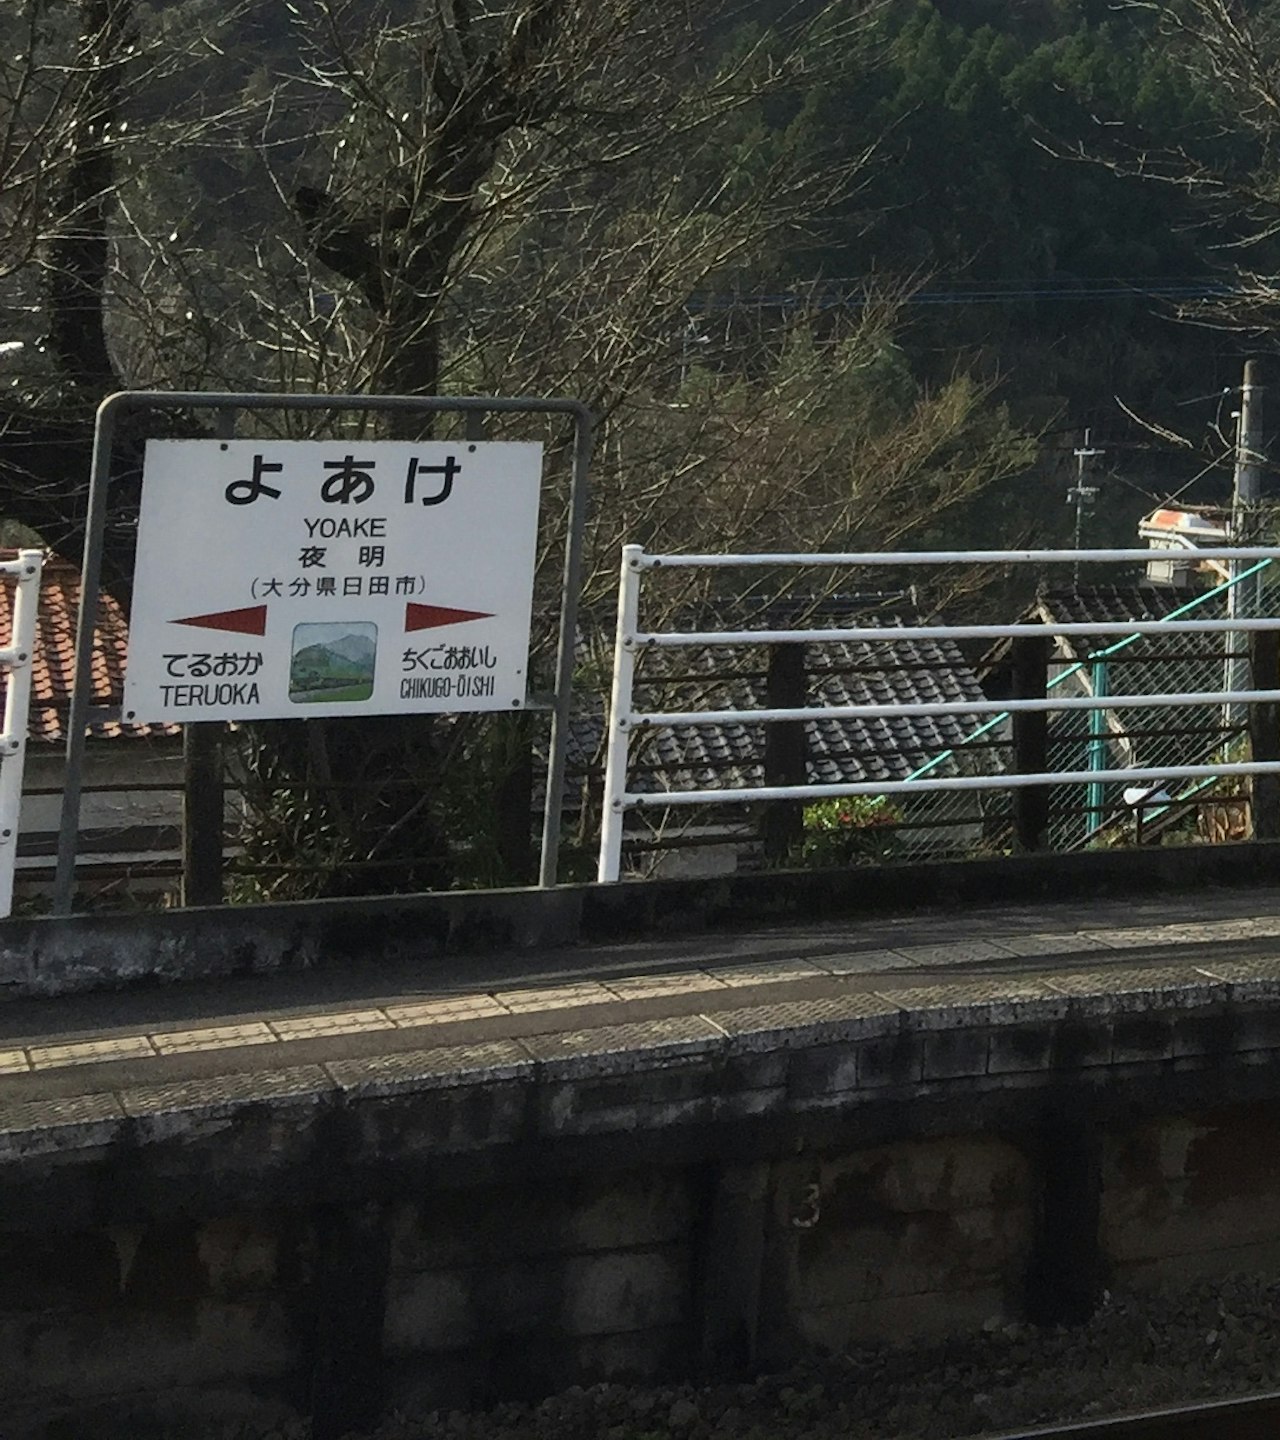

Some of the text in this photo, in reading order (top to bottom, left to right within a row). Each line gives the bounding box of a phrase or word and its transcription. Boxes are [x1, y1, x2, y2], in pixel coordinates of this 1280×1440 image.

[225, 455, 462, 506] よあけ
[303, 517, 388, 539] YOAKE
[298, 545, 386, 569] 夜明
[250, 575, 426, 600] (大分県日田市)
[162, 651, 264, 678] てるおか
[402, 643, 498, 672] ちくごおおいし
[159, 681, 260, 708] TERUOKA
[400, 673, 495, 700] CHIKUGO-ŌISHI
